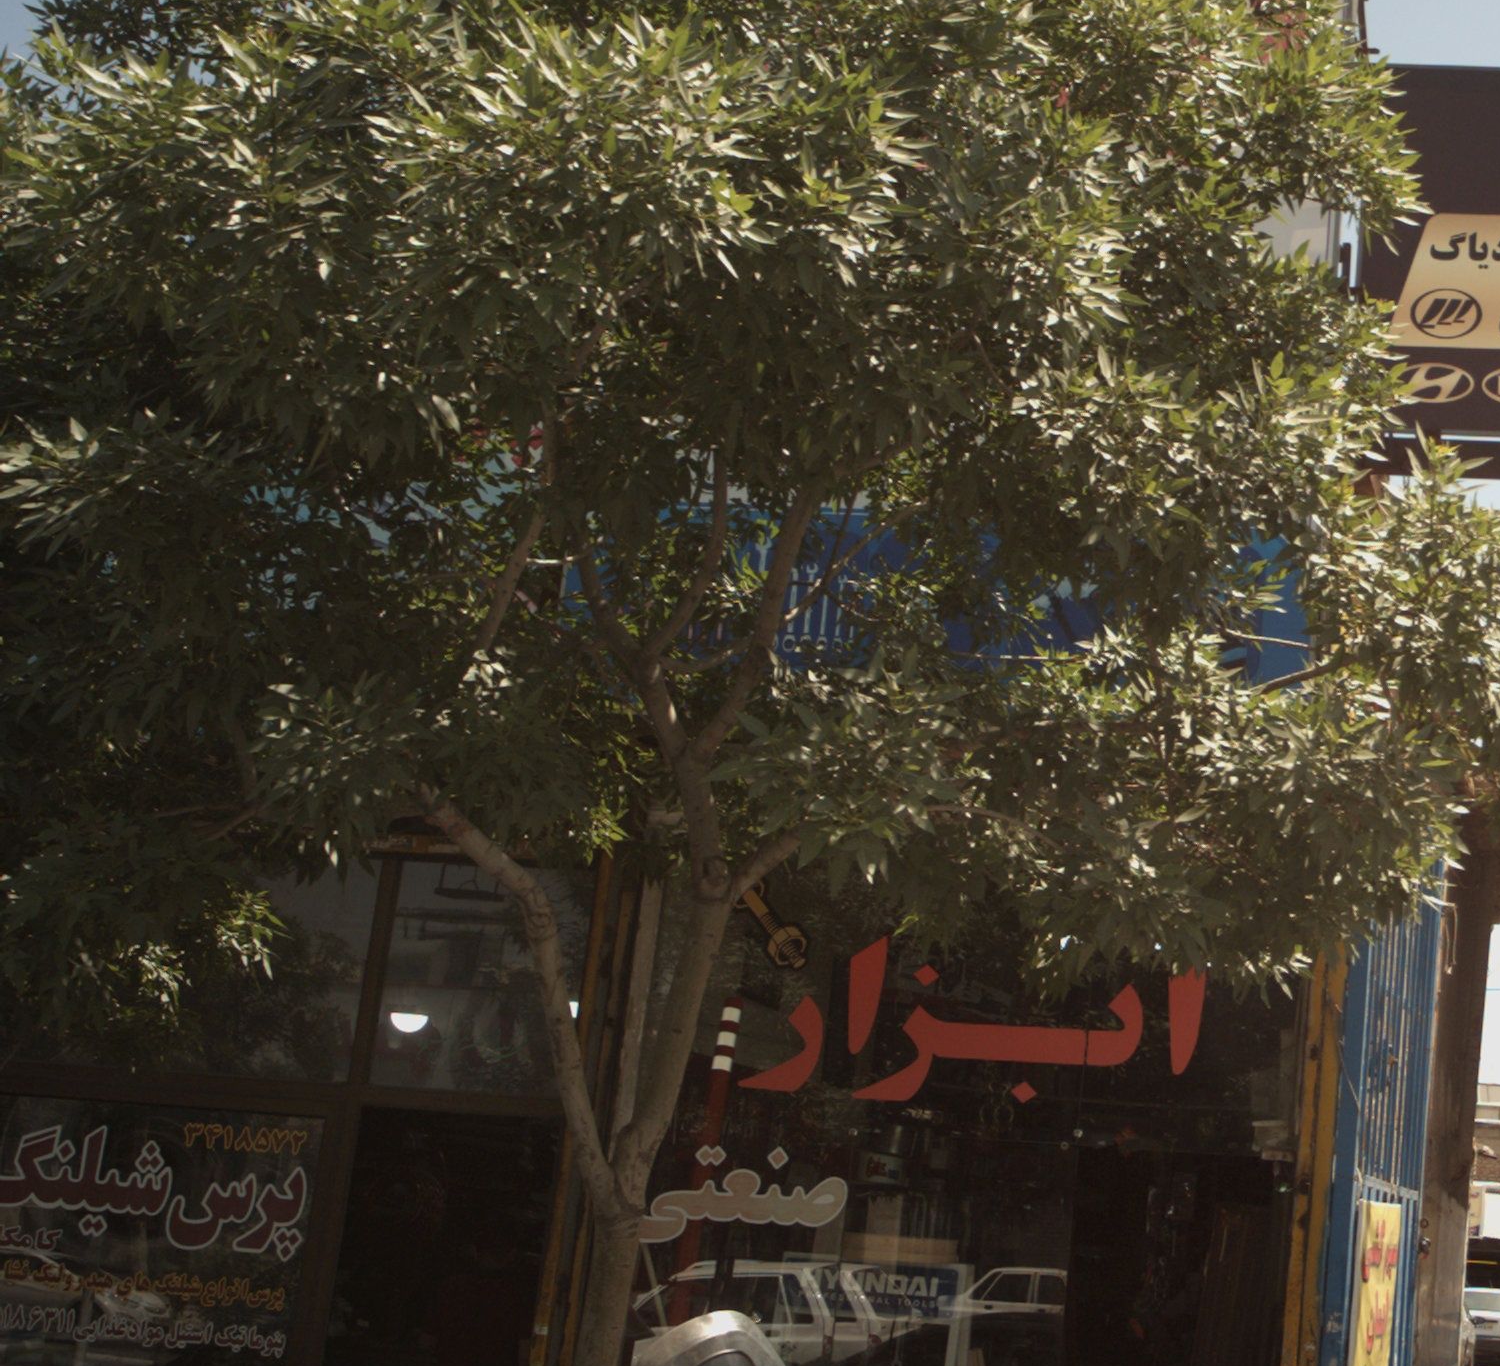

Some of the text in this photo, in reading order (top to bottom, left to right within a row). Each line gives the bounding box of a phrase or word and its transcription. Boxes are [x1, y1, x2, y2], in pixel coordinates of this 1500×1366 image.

[738, 937, 1208, 1104] ابزار
[0, 1125, 308, 1262] پرس شیلنگ
[638, 1145, 850, 1244] صنعتی
